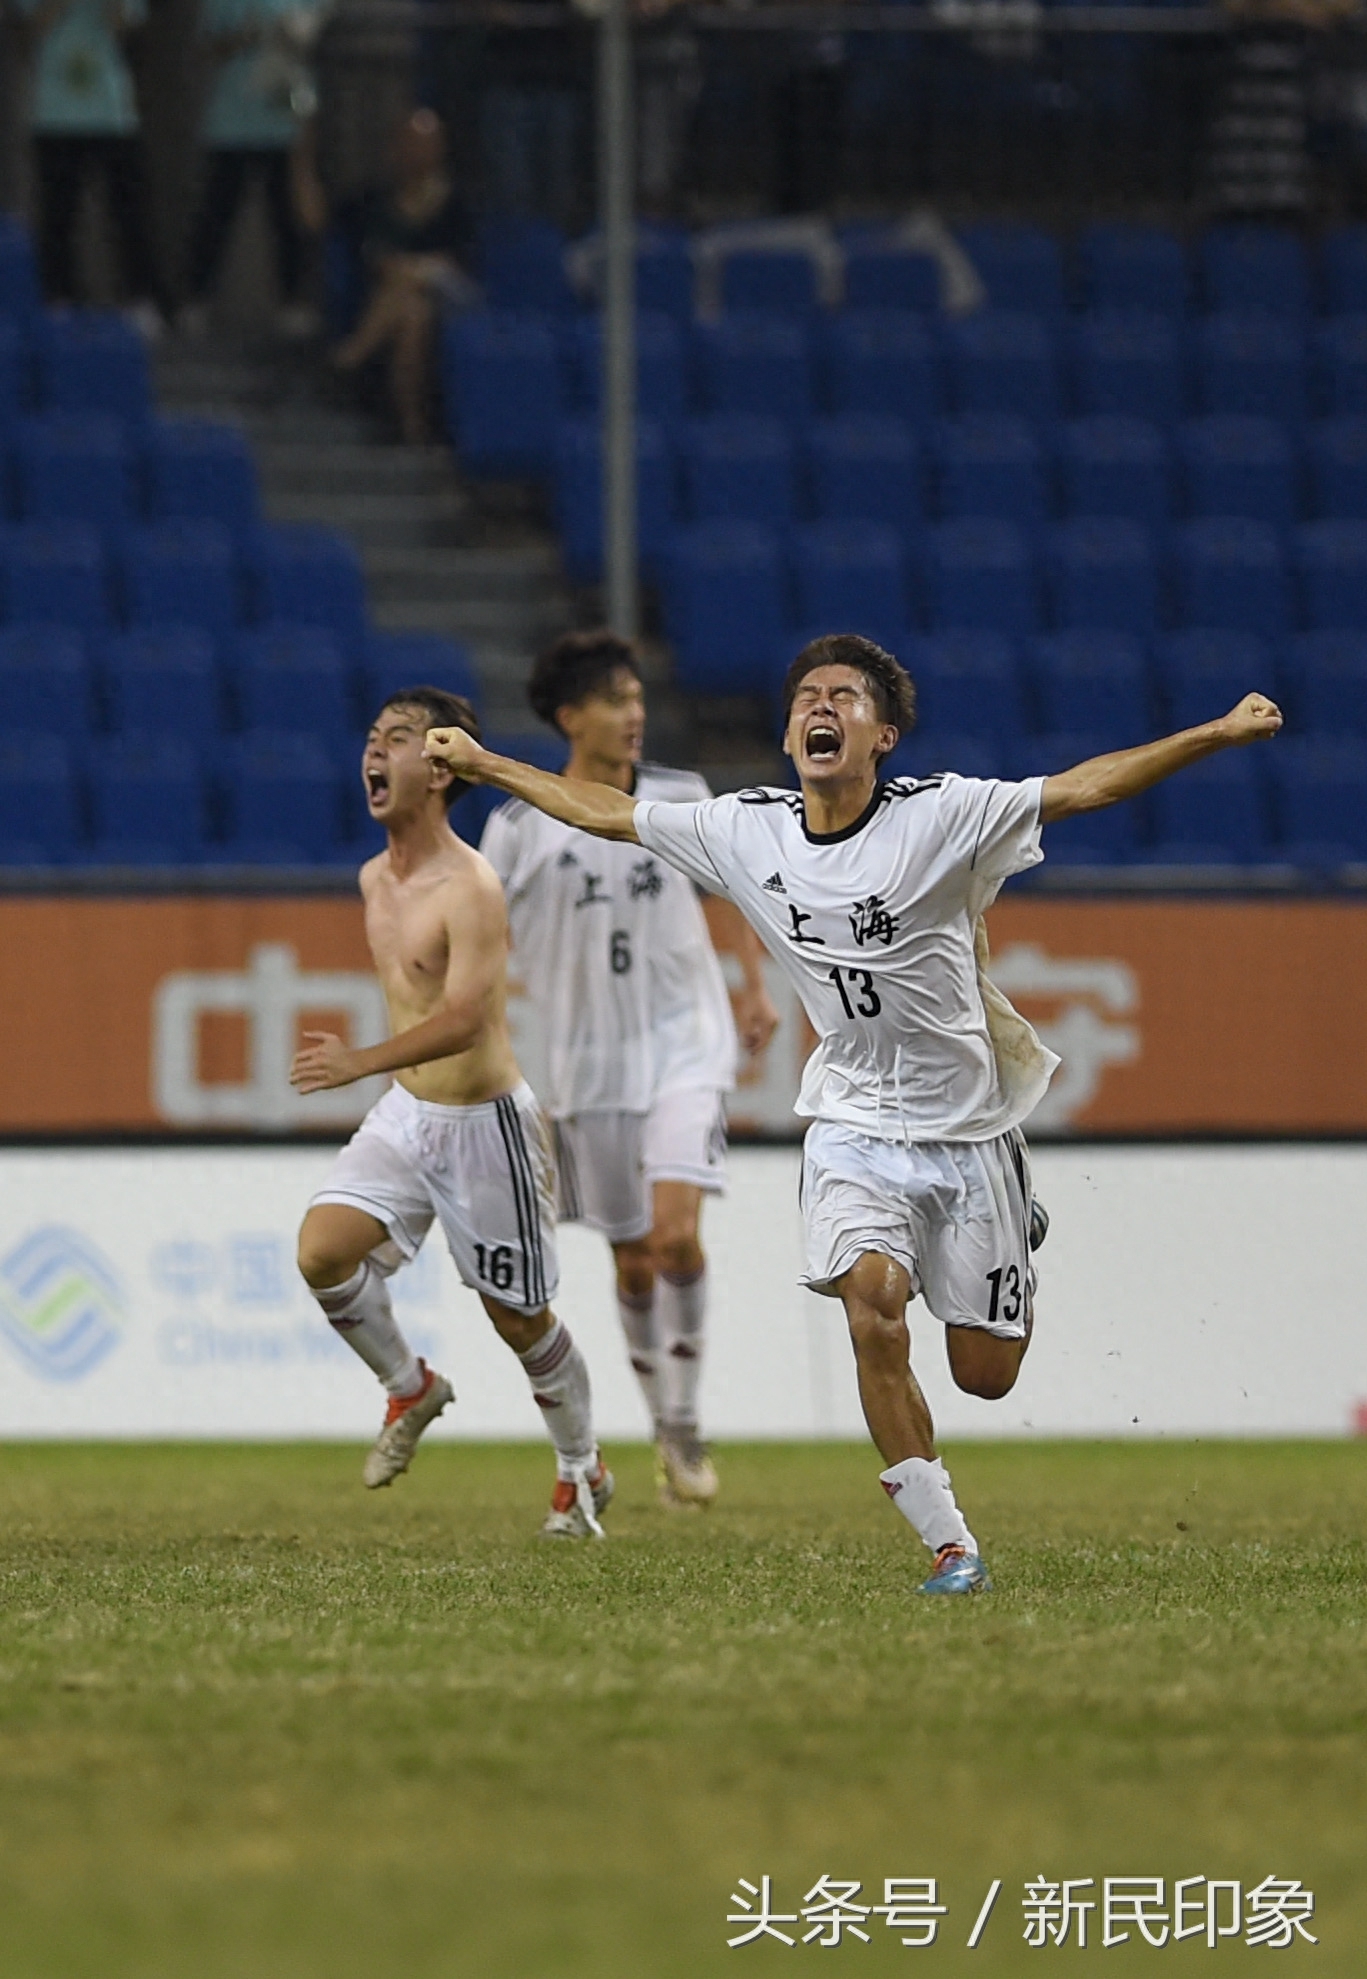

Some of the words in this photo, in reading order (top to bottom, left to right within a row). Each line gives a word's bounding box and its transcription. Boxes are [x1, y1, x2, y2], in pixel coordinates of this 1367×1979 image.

[788, 895, 900, 946] 上海
[610, 930, 632, 975] 6
[829, 966, 881, 1020] 13
[474, 1243, 514, 1290] 16
[986, 1264, 1022, 1323] 13
